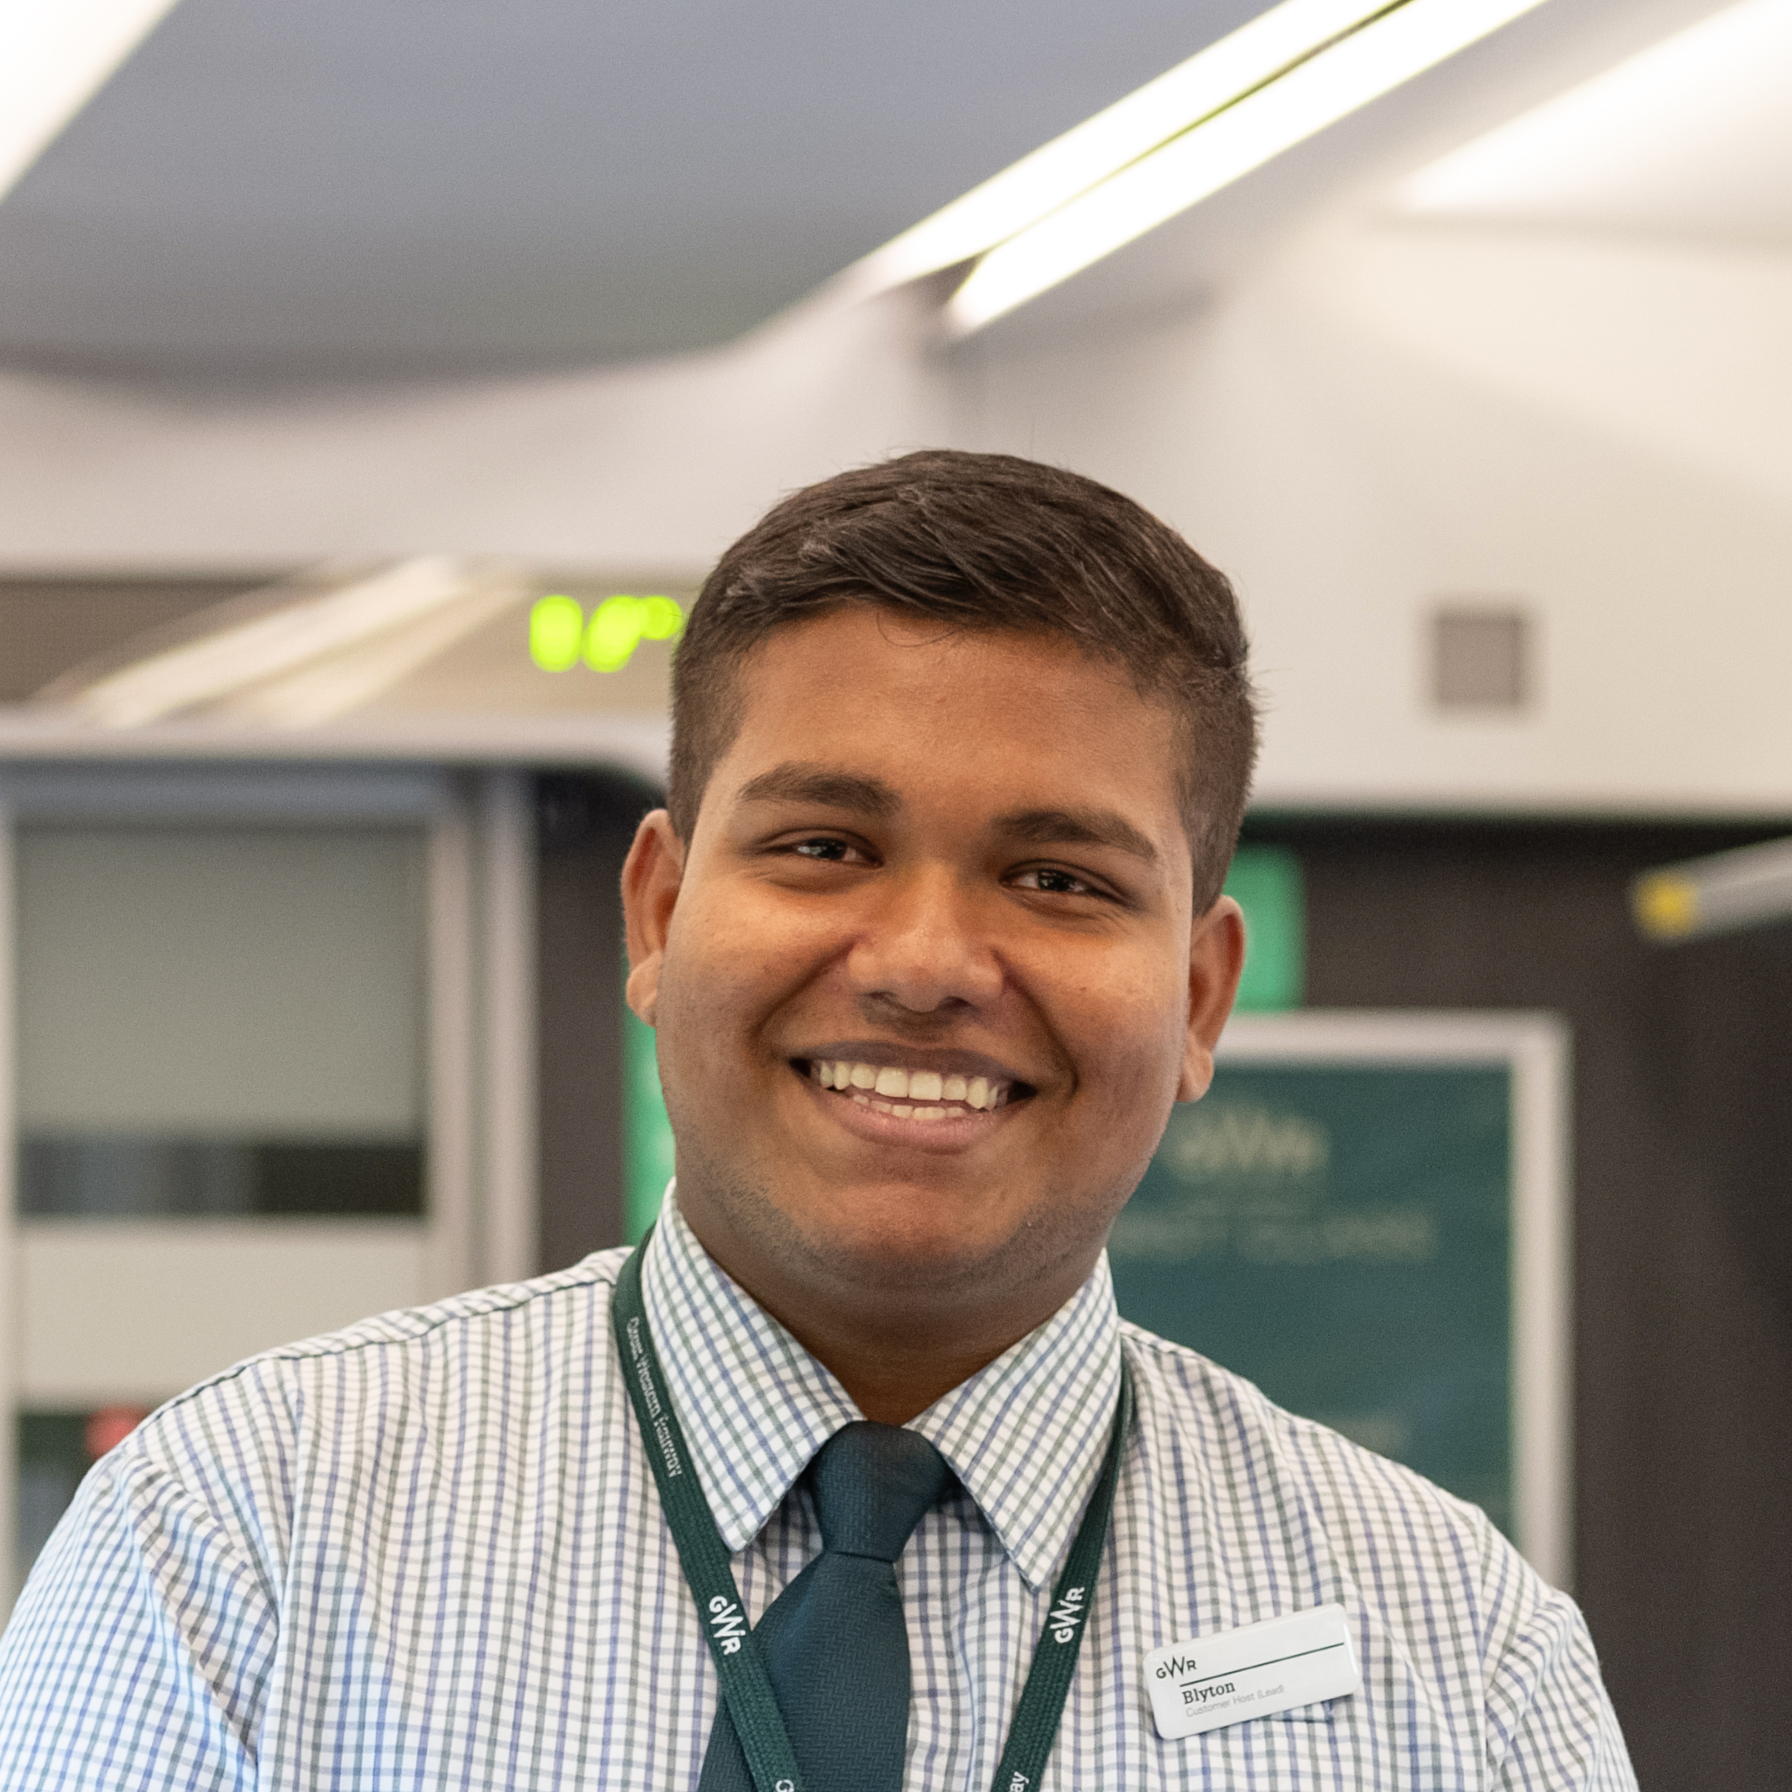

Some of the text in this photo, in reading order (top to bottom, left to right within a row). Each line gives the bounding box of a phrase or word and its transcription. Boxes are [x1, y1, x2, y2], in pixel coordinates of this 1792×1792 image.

[709, 1595, 746, 1656] GWR
[1050, 1586, 1085, 1644] GWR
[1156, 1655, 1197, 1679] GWR
[1182, 1682, 1236, 1705] Blyton
[1185, 1699, 1231, 1719] Customer
[1233, 1692, 1256, 1706] Host
